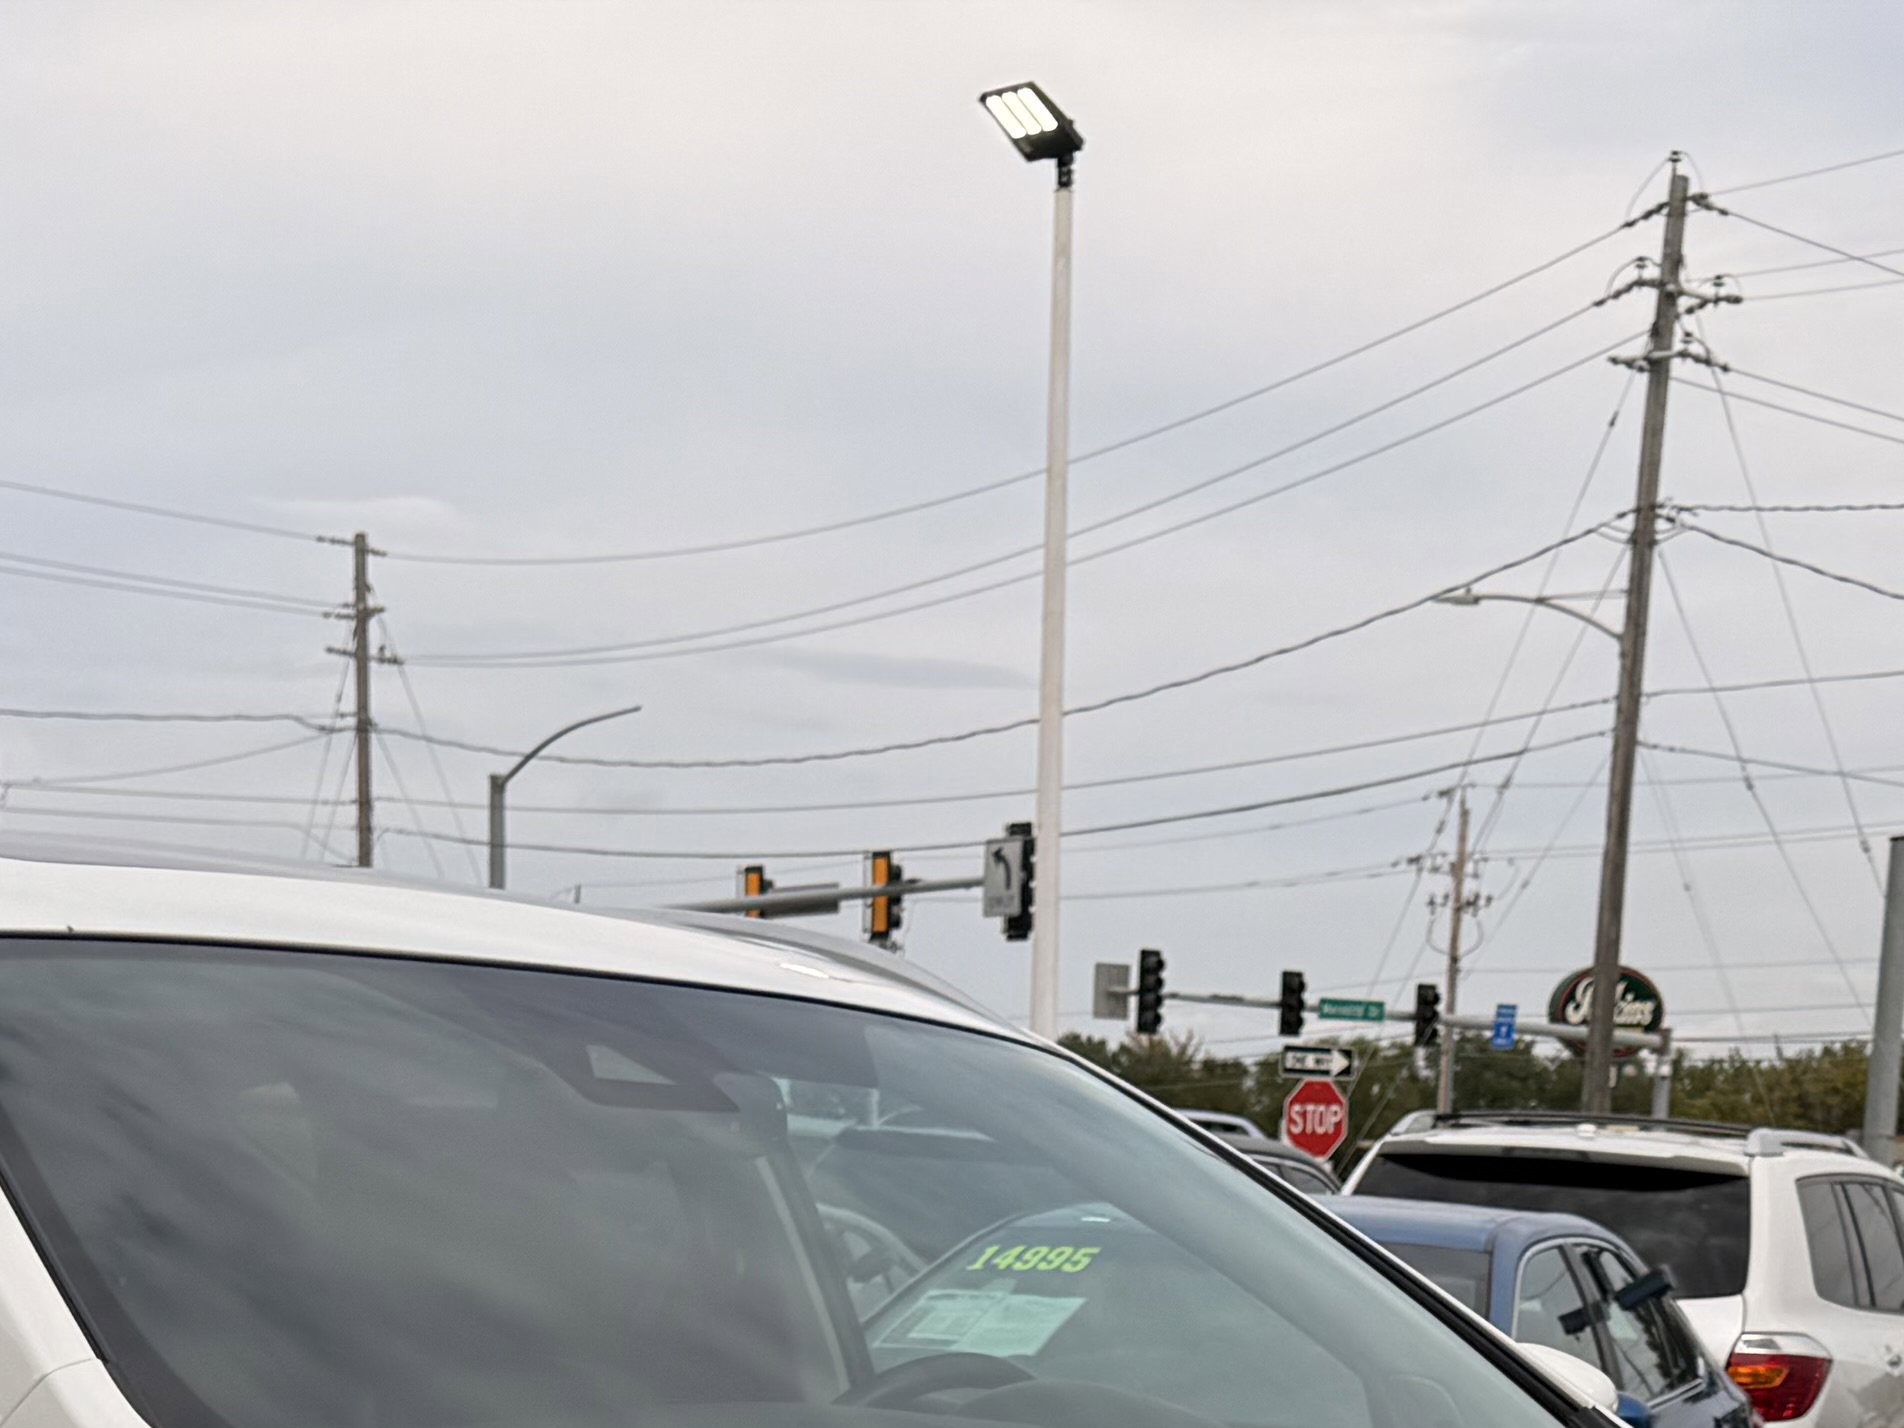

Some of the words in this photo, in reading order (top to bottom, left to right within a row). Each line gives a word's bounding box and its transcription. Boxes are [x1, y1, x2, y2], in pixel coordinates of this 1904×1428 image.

[1565, 976, 1656, 1026] Pkins
[1289, 1103, 1343, 1135] STOP
[966, 1245, 1102, 1273] 14995
